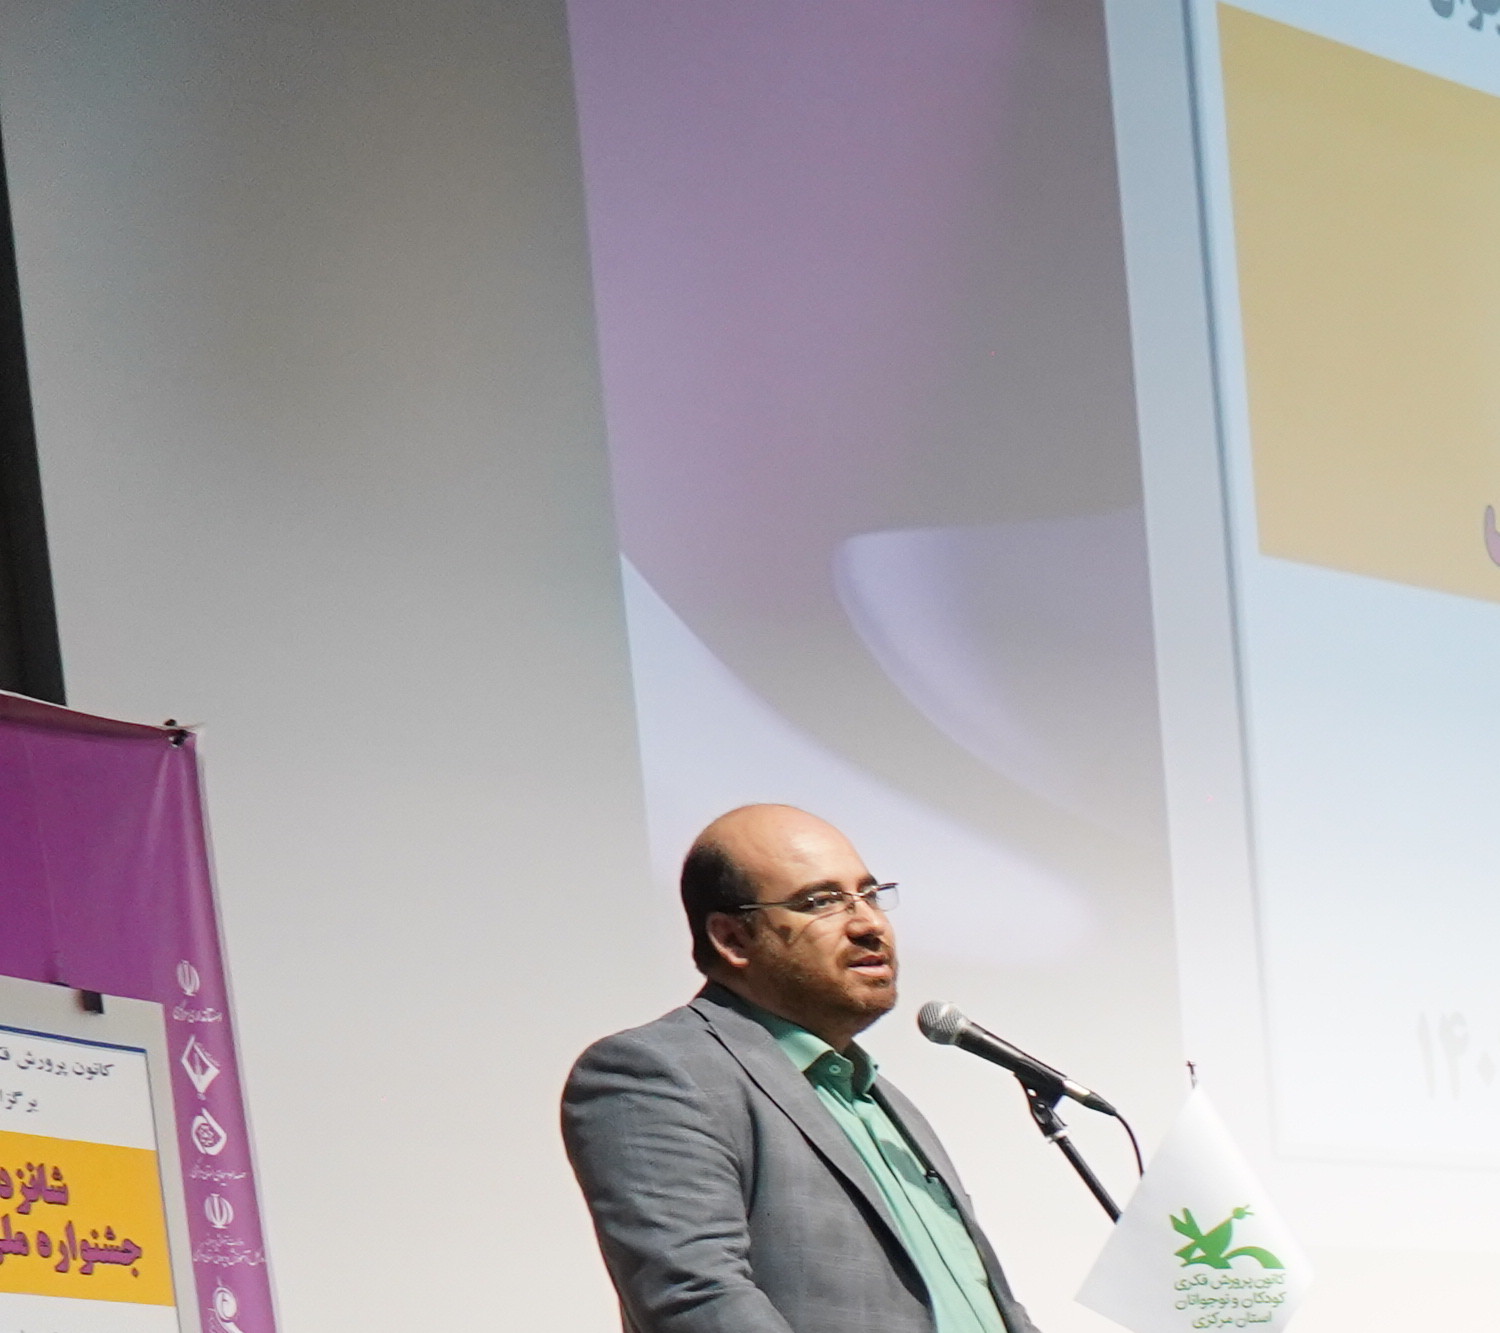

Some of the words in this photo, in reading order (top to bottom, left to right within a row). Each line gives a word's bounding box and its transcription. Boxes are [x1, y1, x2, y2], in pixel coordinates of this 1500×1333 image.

[17, 1051, 69, 1077] پرورش
[72, 1062, 115, 1081] کانون
[37, 1220, 143, 1279] جشنواره
[1174, 1273, 1208, 1291] فکری
[1192, 1311, 1233, 1330] مرکزی
